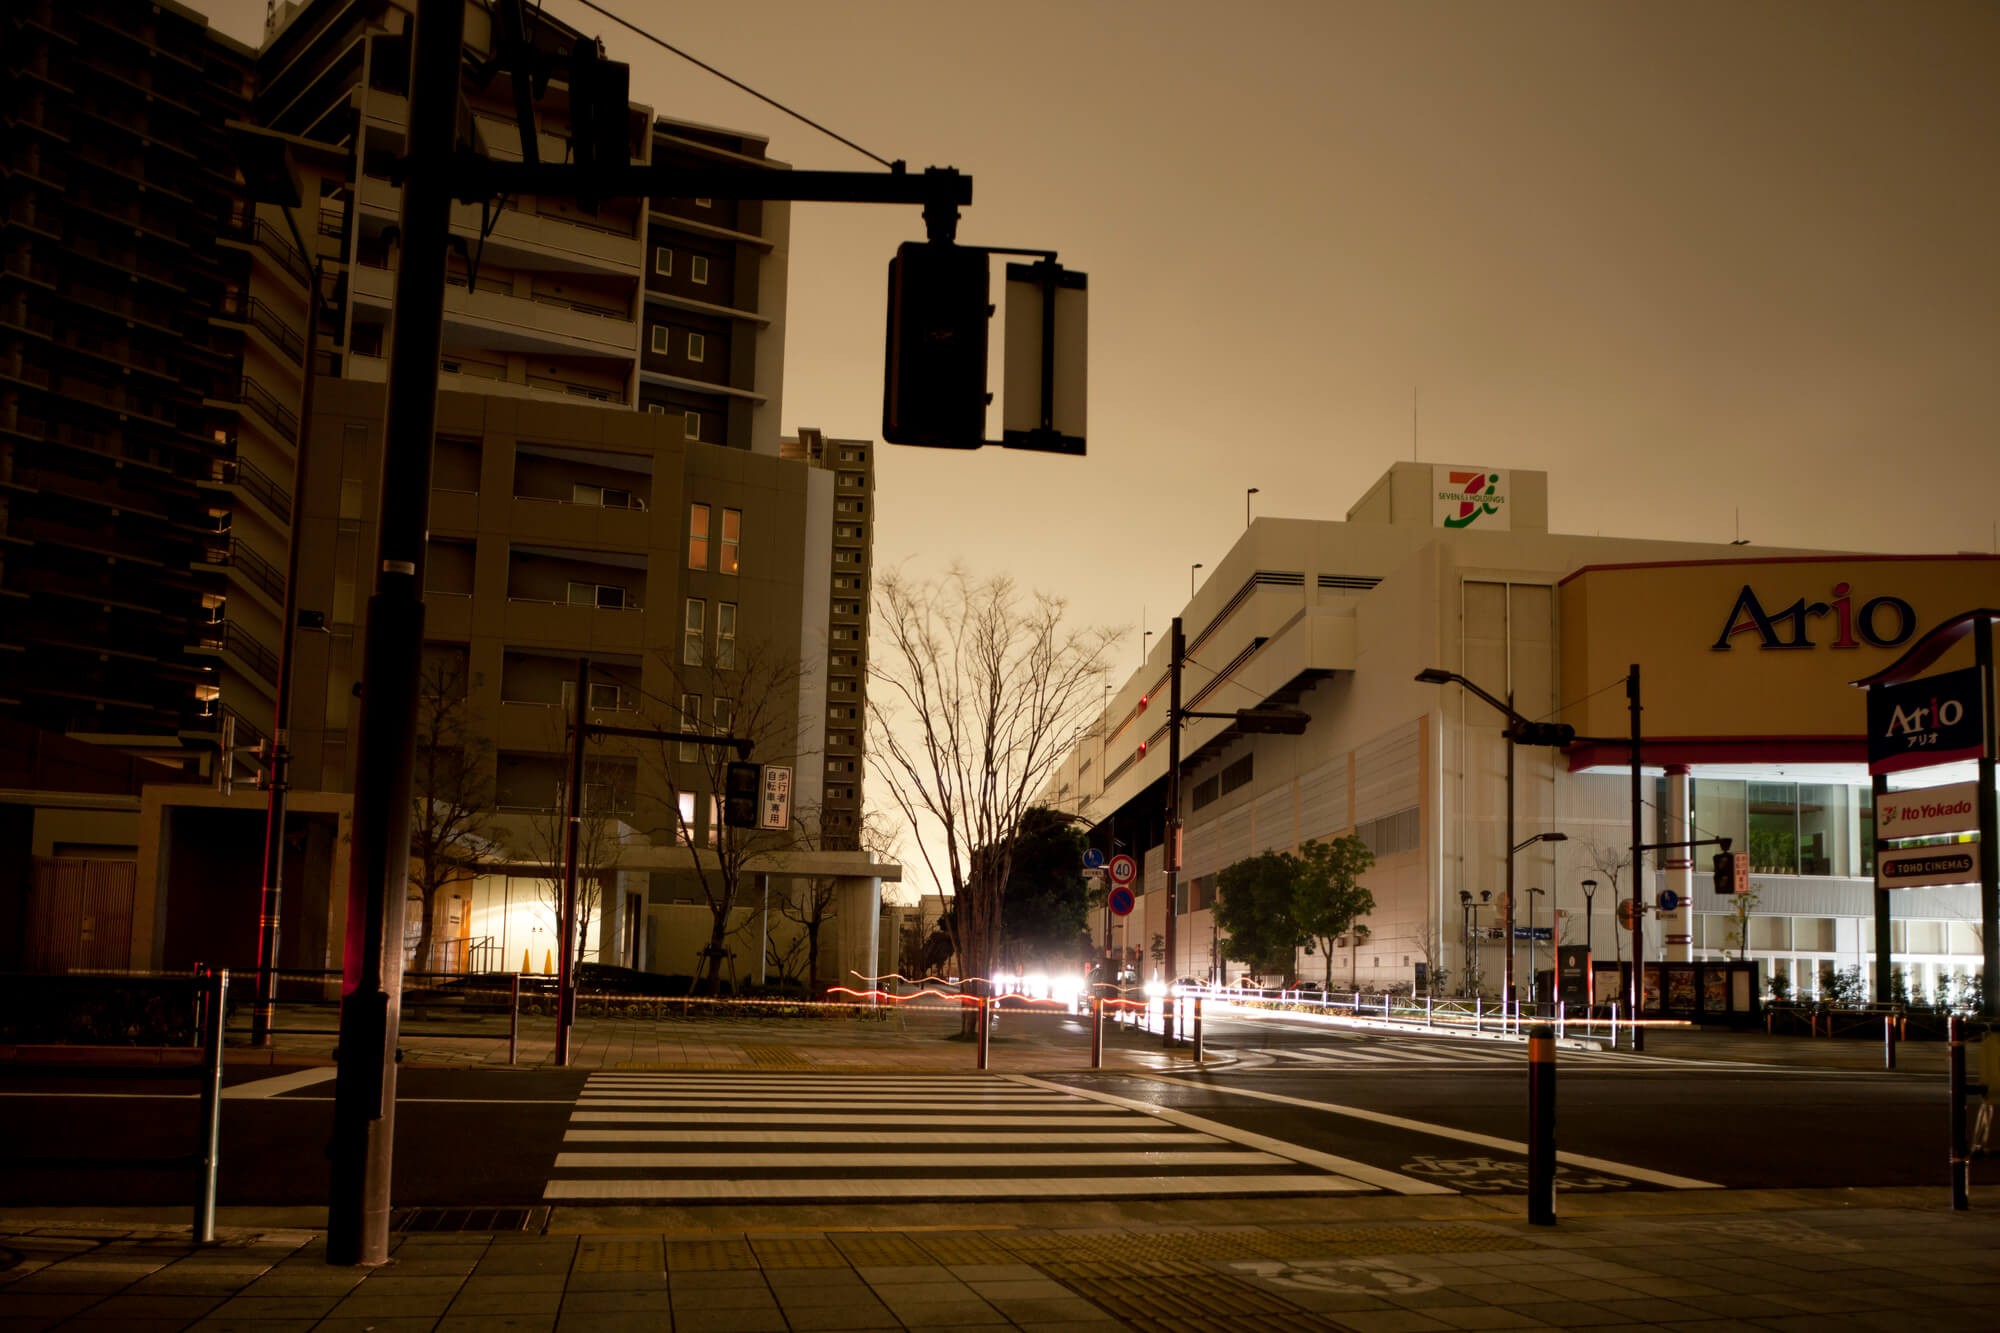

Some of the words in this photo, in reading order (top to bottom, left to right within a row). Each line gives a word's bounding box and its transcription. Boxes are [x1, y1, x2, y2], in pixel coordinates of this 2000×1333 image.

[1711, 582, 1917, 650] Ario
[1884, 696, 1964, 737] Ario
[1906, 731, 1939, 748] アリオ
[1116, 863, 1130, 876] 40
[1897, 863, 1923, 873] TOHO
[1924, 859, 1970, 872] CINEMAS
